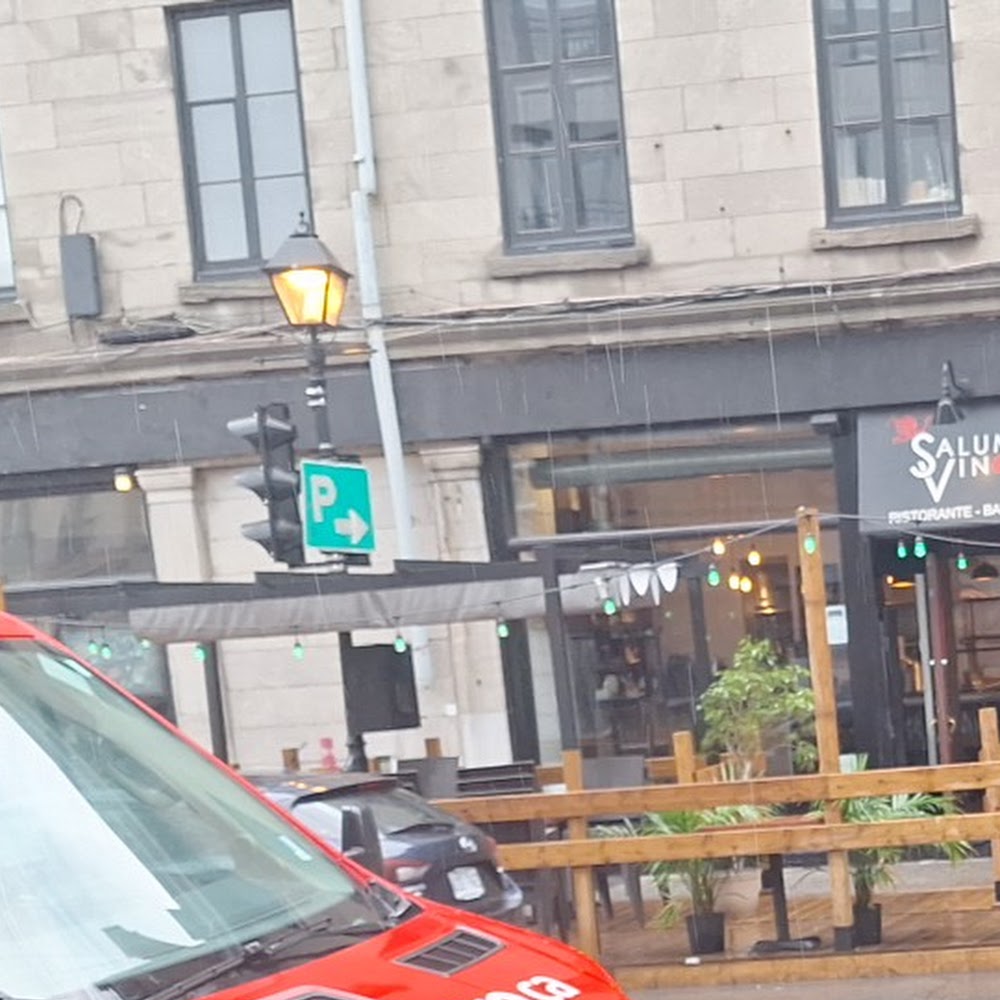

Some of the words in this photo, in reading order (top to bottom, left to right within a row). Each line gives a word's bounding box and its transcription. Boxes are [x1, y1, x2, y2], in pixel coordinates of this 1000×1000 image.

[310, 474, 338, 523] P
[922, 457, 990, 503] VIN
[888, 505, 973, 525] RISTORANTE
